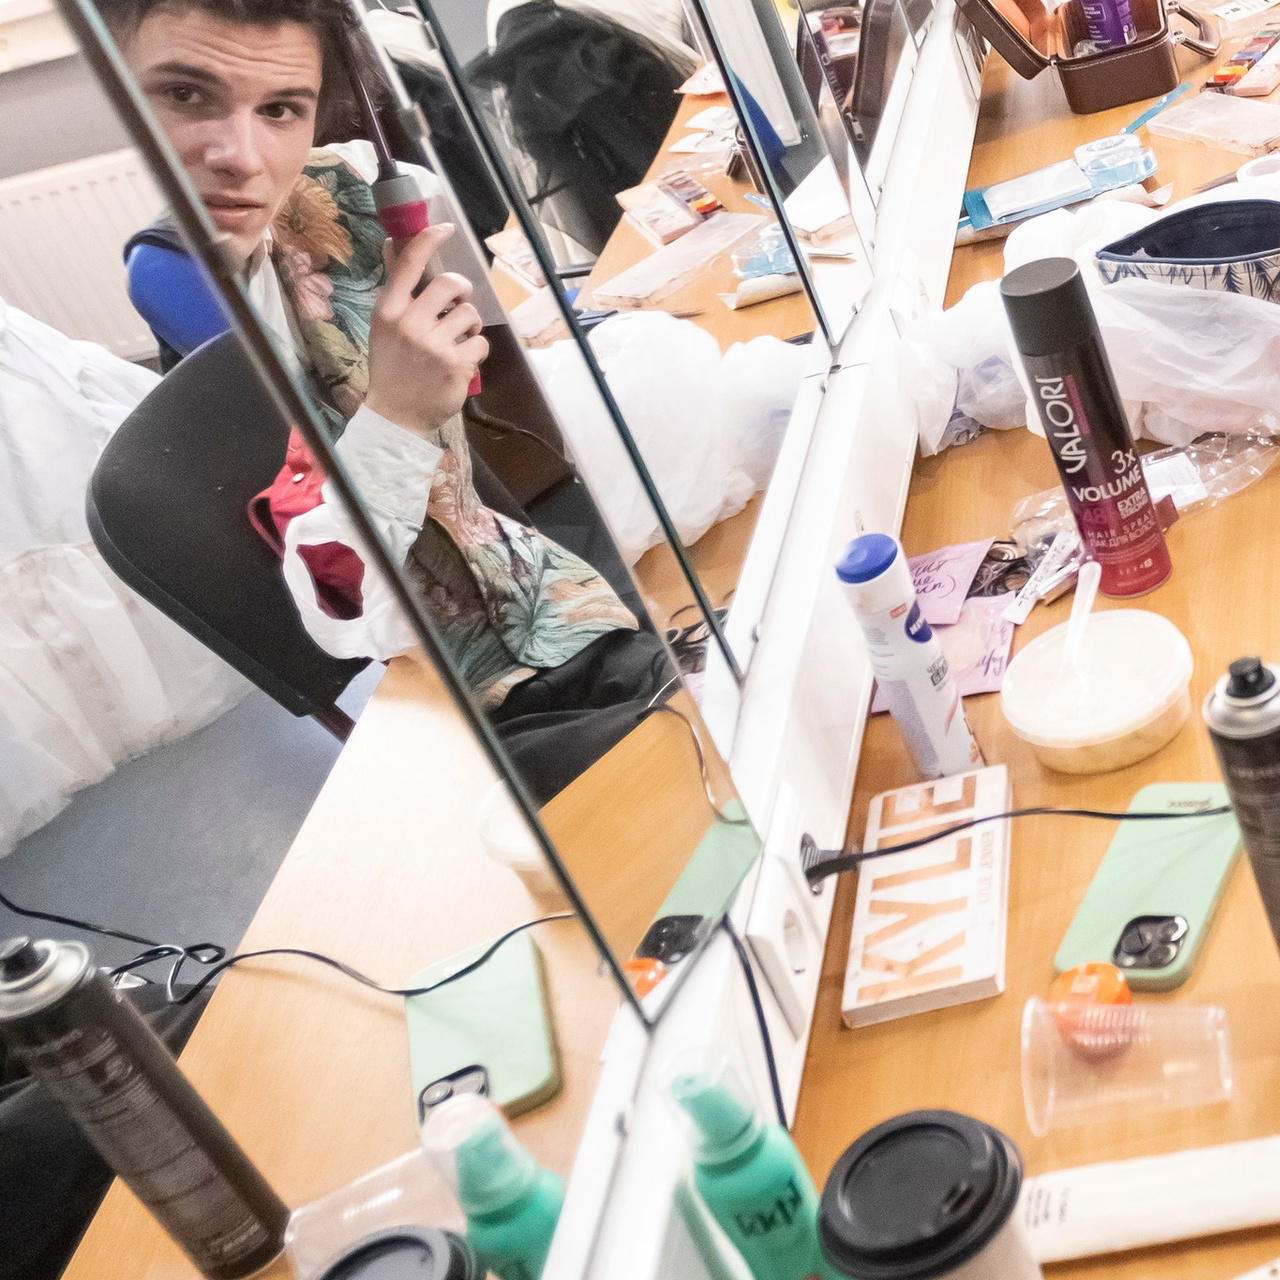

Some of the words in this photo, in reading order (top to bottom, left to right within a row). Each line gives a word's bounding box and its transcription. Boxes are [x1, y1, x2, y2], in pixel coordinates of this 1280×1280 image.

[1036, 376, 1087, 474] VALORI
[1111, 448, 1136, 474] 3x
[1072, 464, 1142, 502] VOLUME
[1117, 487, 1147, 511] EXTRA
[1087, 529, 1116, 540] HAIR
[857, 775, 977, 1001] KYLIE
